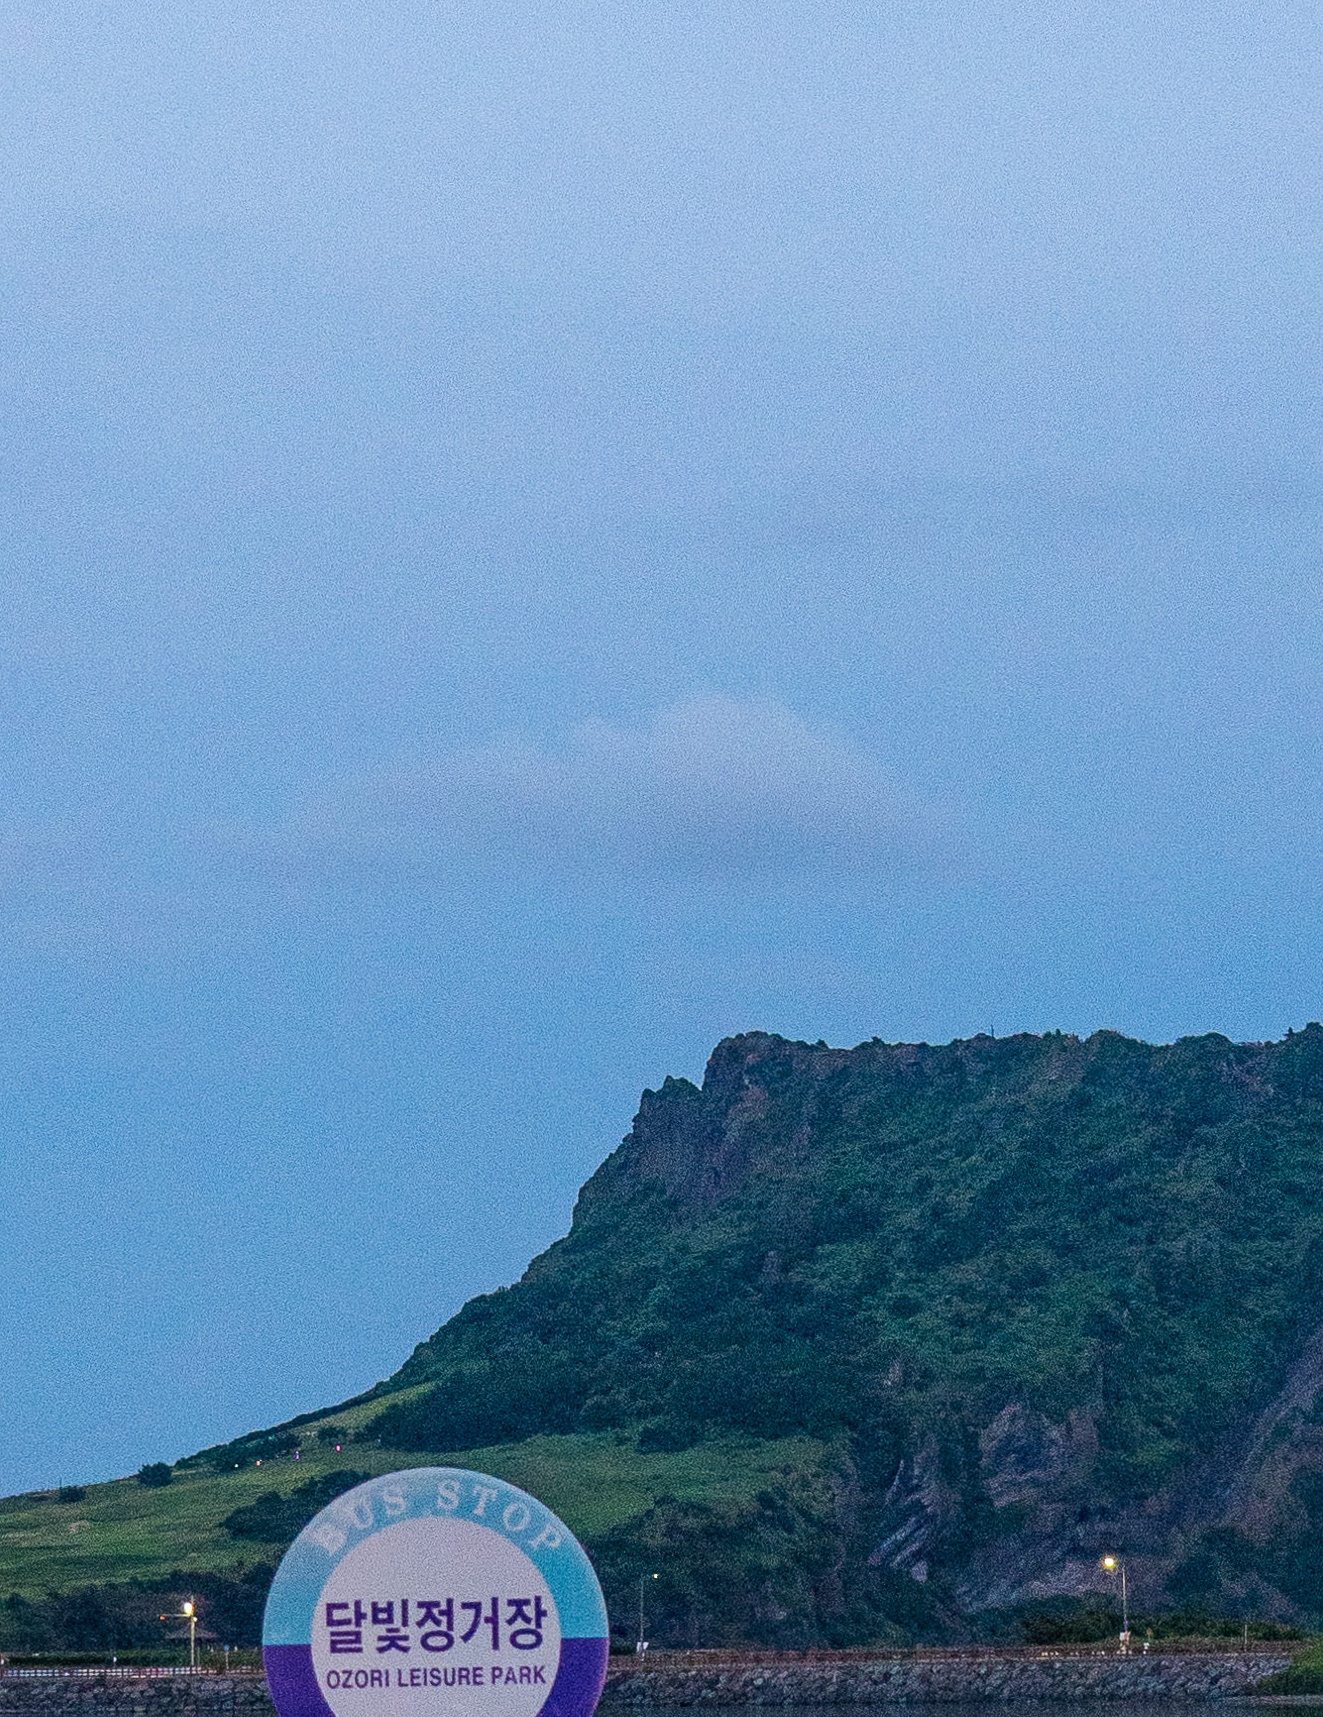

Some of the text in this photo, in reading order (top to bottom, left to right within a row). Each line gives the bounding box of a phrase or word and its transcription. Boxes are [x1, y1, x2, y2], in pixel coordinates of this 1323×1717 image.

[436, 1479, 563, 1550] STOP
[326, 1595, 548, 1654] 달빛정거장
[327, 1665, 547, 1690] OZORI LEISURE PARK
